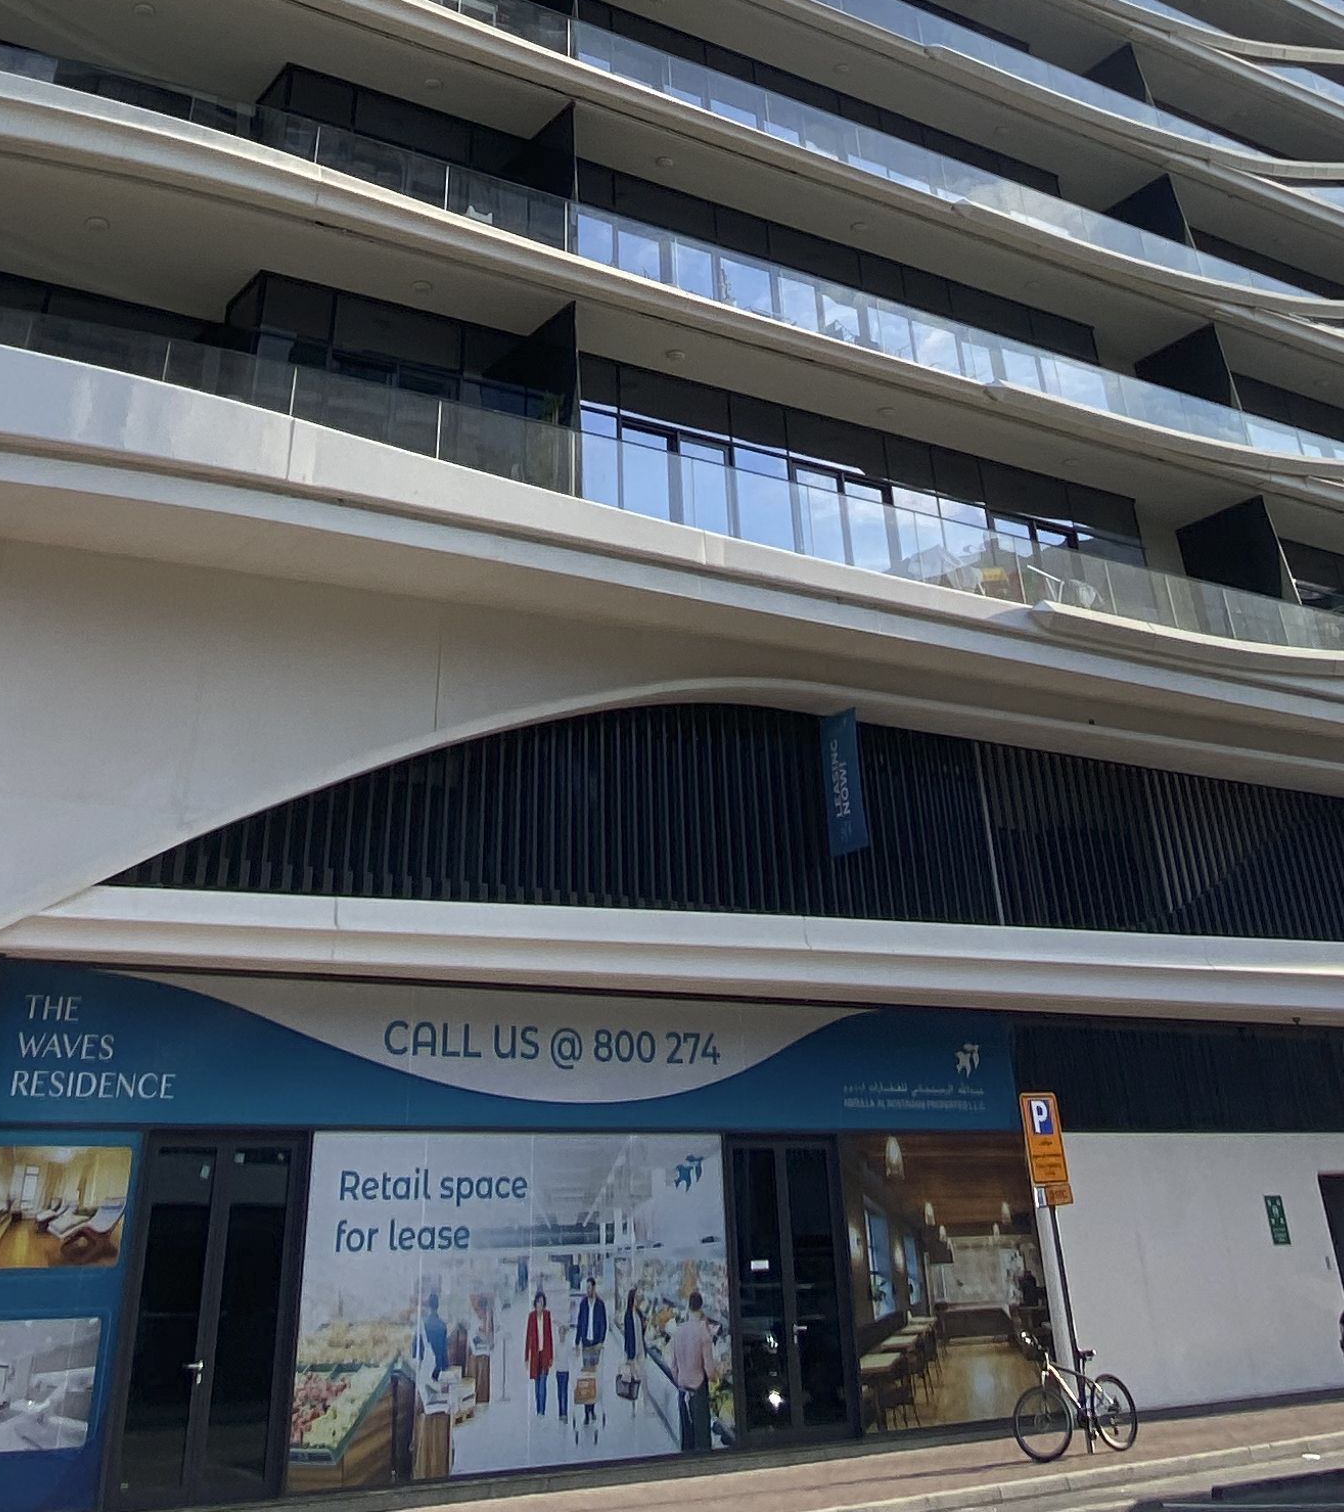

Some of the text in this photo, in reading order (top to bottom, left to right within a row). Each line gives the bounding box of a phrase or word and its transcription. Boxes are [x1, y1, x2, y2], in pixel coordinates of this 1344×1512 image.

[25, 993, 82, 1022] THE
[18, 1031, 114, 1060] WAVES
[384, 1020, 721, 1070] CALL US @ 800 274
[10, 1070, 176, 1099] RESIDENCE
[1031, 1099, 1049, 1135] P
[339, 1167, 528, 1207] Retail space
[335, 1218, 470, 1252] for lease
